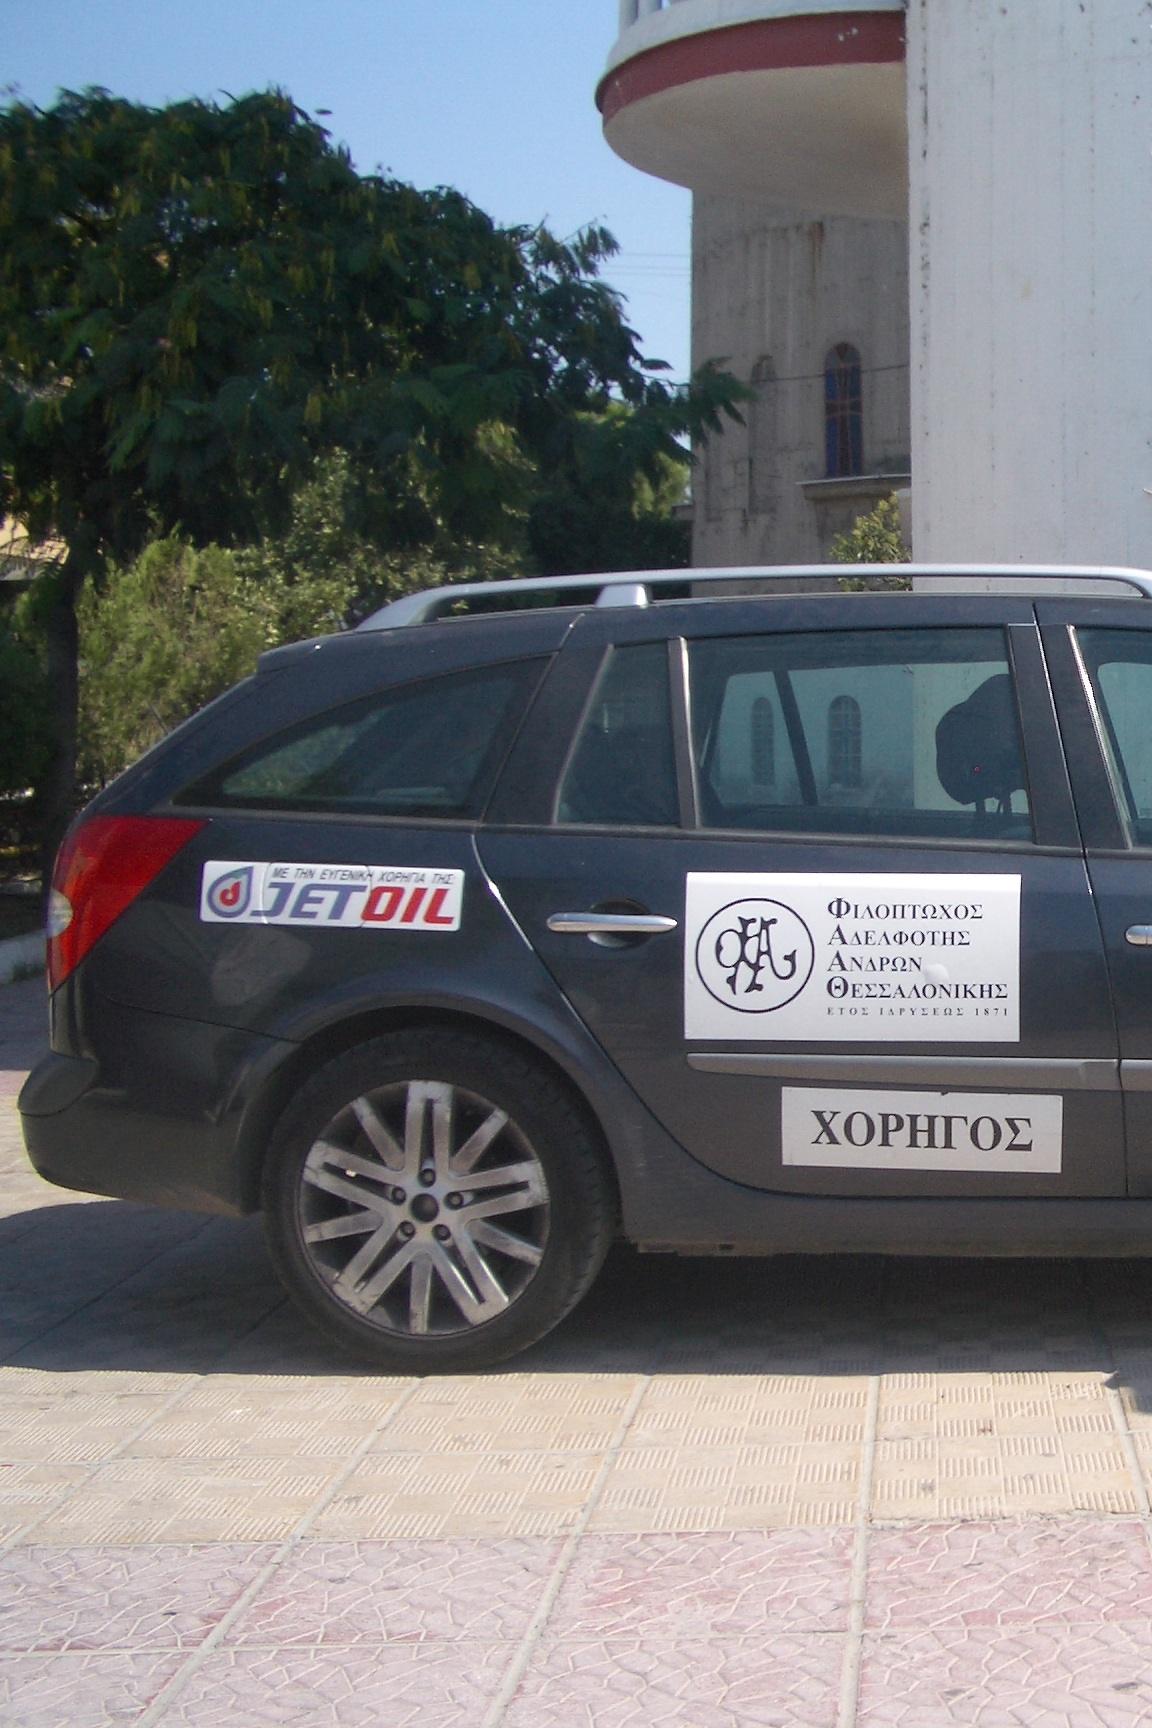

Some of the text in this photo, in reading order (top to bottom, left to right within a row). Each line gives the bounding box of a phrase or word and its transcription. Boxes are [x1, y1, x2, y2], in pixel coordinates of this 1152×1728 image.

[272, 867, 455, 885] ΜΕ ΤΗΝ ΕΥΓΕΝΙΚΗ ΧΟΡΗΓΙΑ ΤΗΣ
[250, 882, 455, 924] JETOIL
[828, 898, 983, 920] ΦΙΛΟΠΤΩΧΟΣ
[827, 924, 970, 947] ΑΔΕΛΦΟΤΗΣ
[826, 950, 922, 972] ΑΝΔΡΩΝ
[826, 976, 1009, 999] ΘΕΣΣΑΛΟΝΙΚΗΣ
[826, 1007, 1009, 1017] ΕΤΟΣ ΙΔΡΥΣΕΩΣ 1871
[811, 1109, 1034, 1152] ΧΟΡΗΓΟΣ
